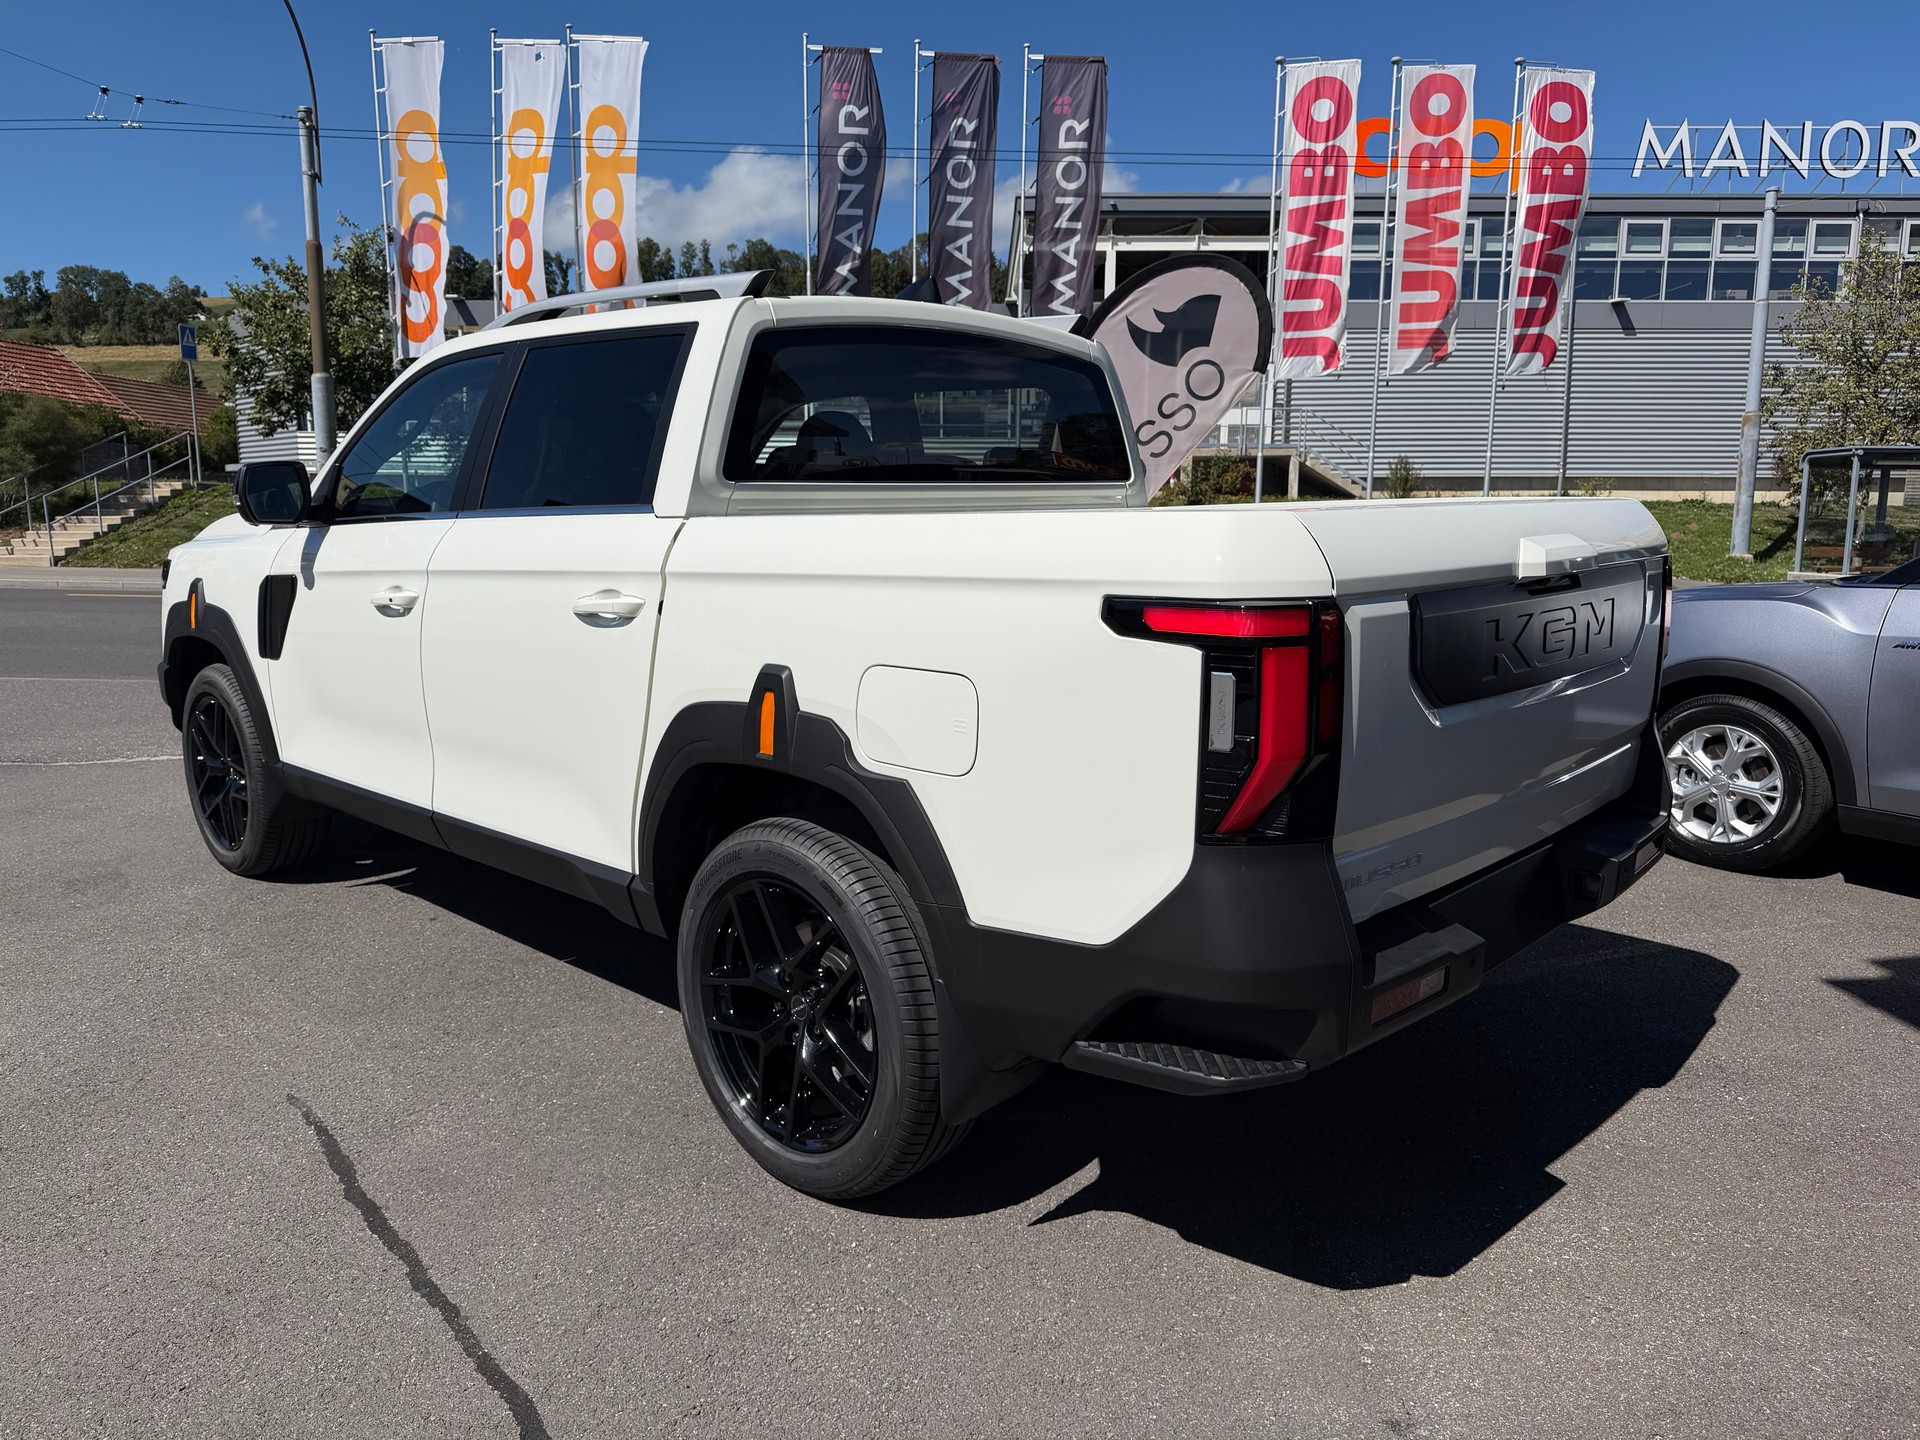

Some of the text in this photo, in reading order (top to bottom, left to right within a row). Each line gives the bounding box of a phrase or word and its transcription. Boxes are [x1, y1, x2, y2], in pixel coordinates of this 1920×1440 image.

[395, 110, 447, 343] coop
[834, 104, 869, 296] MANOR
[945, 116, 979, 310] MANOR
[1047, 117, 1090, 315] MANOR
[1283, 76, 1353, 371] JUMBO
[1397, 72, 1467, 364] JUMBO
[1512, 81, 1588, 368] JUMBO
[1631, 118, 1920, 179] MANOR
[1482, 598, 1615, 681] KGM
